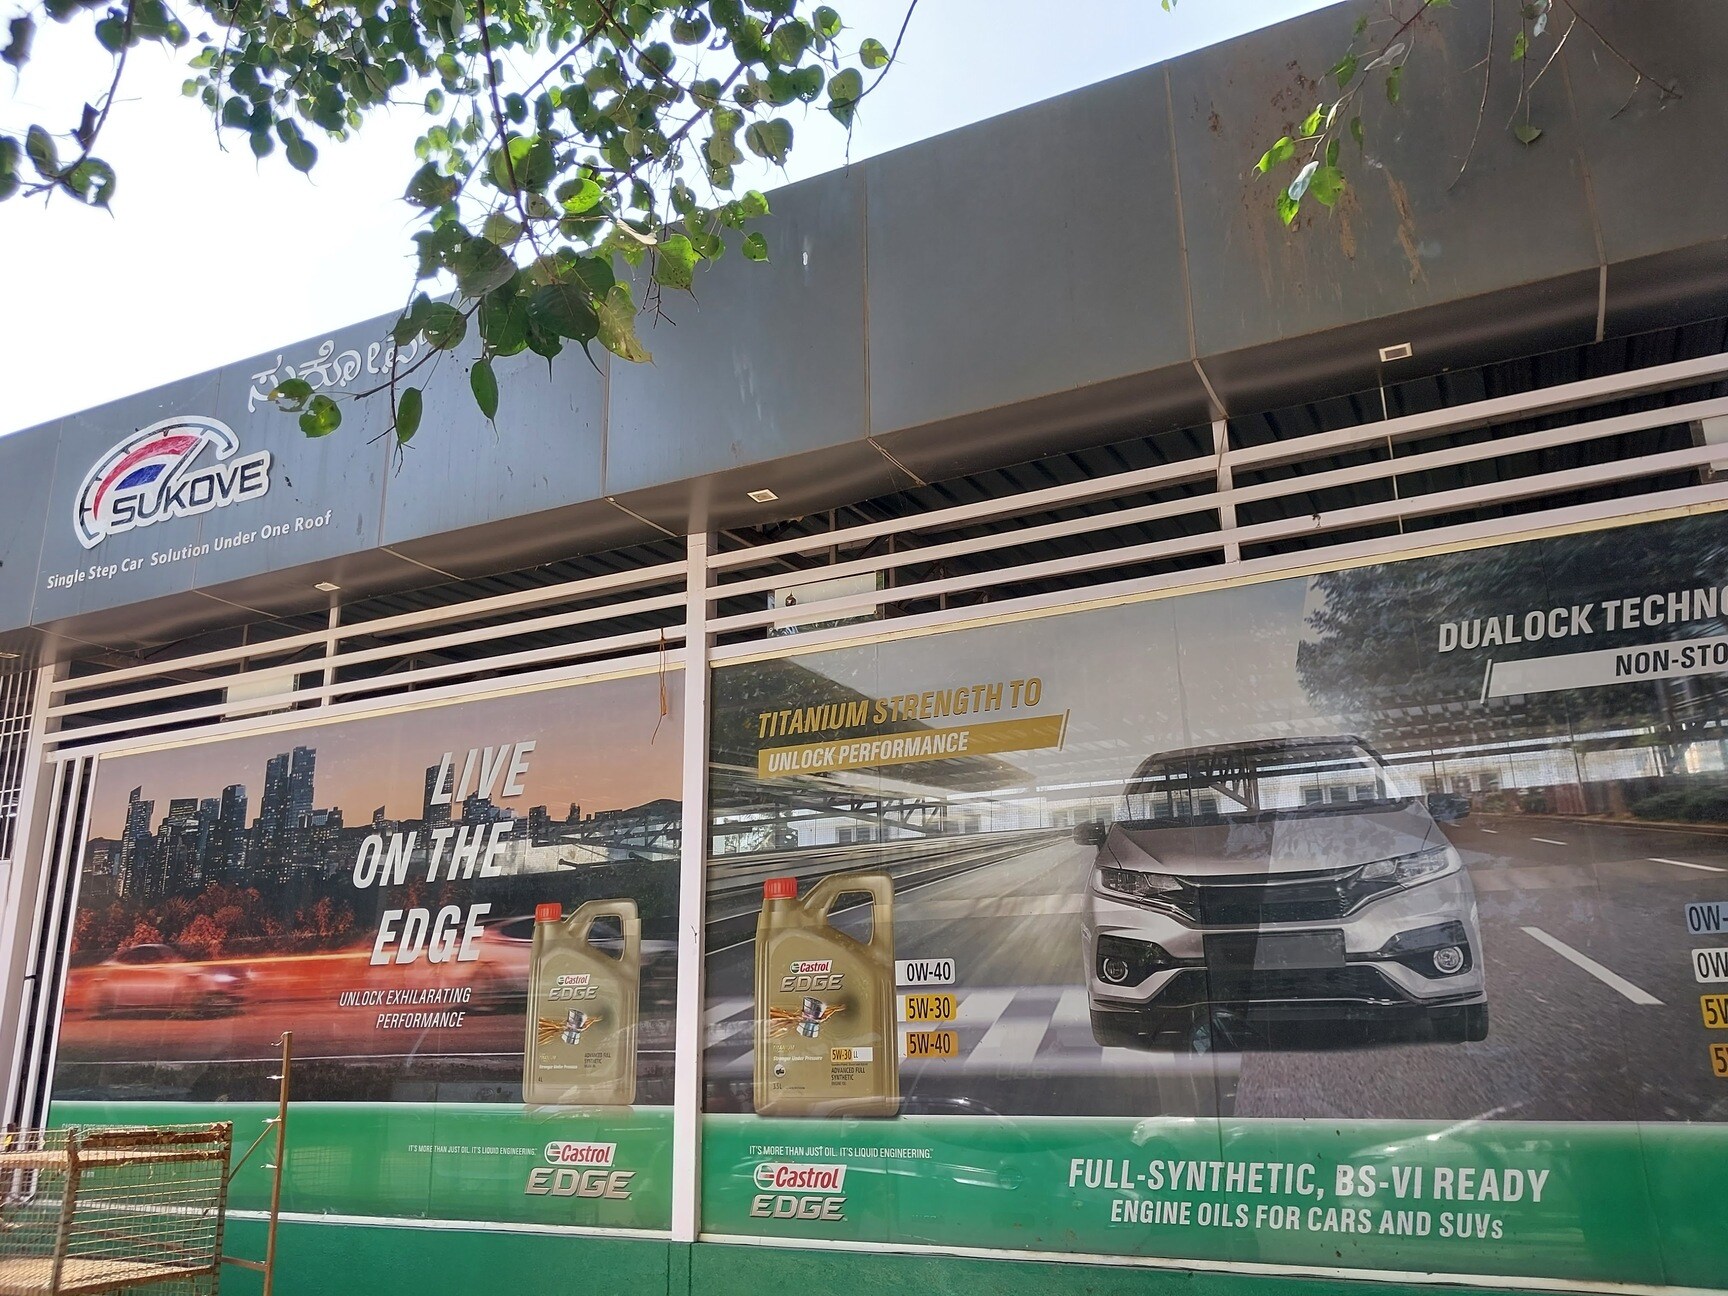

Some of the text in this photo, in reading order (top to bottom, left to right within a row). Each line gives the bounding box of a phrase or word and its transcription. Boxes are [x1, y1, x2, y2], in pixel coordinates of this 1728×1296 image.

[110, 457, 265, 527] SUKOVE
[47, 510, 333, 590] Single Step Car Solution Under One Roof
[1438, 603, 1594, 653] DUALOCK
[758, 676, 1043, 739] TITANIUM STRENGTH TO
[767, 731, 969, 773] UNLOCK PERFORMANCE
[430, 740, 537, 806] LIVE
[352, 821, 513, 889] ON THE
[370, 903, 491, 966] EDGE
[800, 961, 830, 973] Castrol
[906, 961, 951, 982] 0W-40
[564, 975, 588, 985] Castrol
[780, 974, 845, 992] EDGE
[339, 987, 471, 1007] UNLOCK EXHILARATING
[548, 985, 599, 1001] EDGE
[376, 1011, 465, 1029] PERFORMANCE
[908, 997, 951, 1020] 5W-30
[832, 1049, 852, 1060] 5W-30
[909, 1032, 952, 1055] 5W-40
[831, 1066, 855, 1074] ADVANCED
[418, 1145, 433, 1153] MORE
[434, 1145, 447, 1153] THAN
[447, 1145, 460, 1153] JUST
[481, 1146, 499, 1155] LIQUID
[560, 1143, 612, 1164] Castrol
[749, 1145, 762, 1155] IT'S
[763, 1146, 784, 1156] MORE
[785, 1146, 802, 1156] THAN
[805, 1146, 823, 1157] JUST
[824, 1147, 838, 1157] OIL.
[839, 1147, 853, 1157] IT'S
[854, 1147, 878, 1158] LIQUID
[524, 1167, 638, 1200] EDGE
[774, 1165, 840, 1191] Castrol
[1069, 1157, 1550, 1202] FULL-SYNTHETIC, BS-VI READY
[749, 1194, 849, 1222] EDGE
[1110, 1198, 1504, 1240] ENGINE OILS FOR CARS AND SUVs
